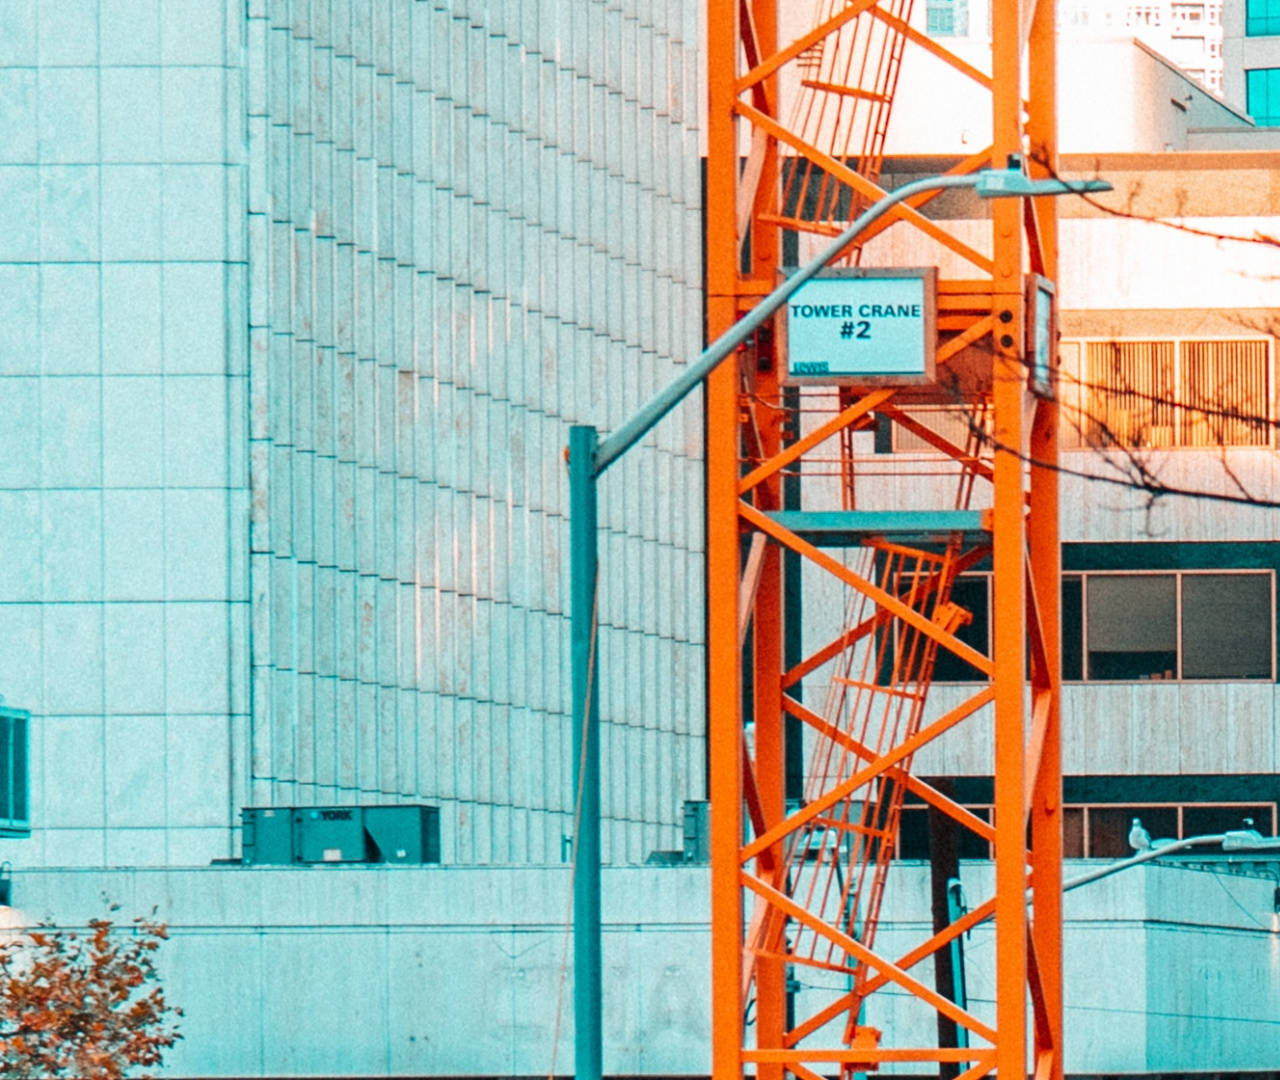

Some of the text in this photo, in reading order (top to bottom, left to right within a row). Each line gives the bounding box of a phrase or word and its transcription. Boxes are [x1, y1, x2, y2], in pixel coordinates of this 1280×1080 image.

[791, 304, 921, 318] TOWER CRANE
[840, 320, 872, 340] #2
[321, 810, 352, 821] YORK
